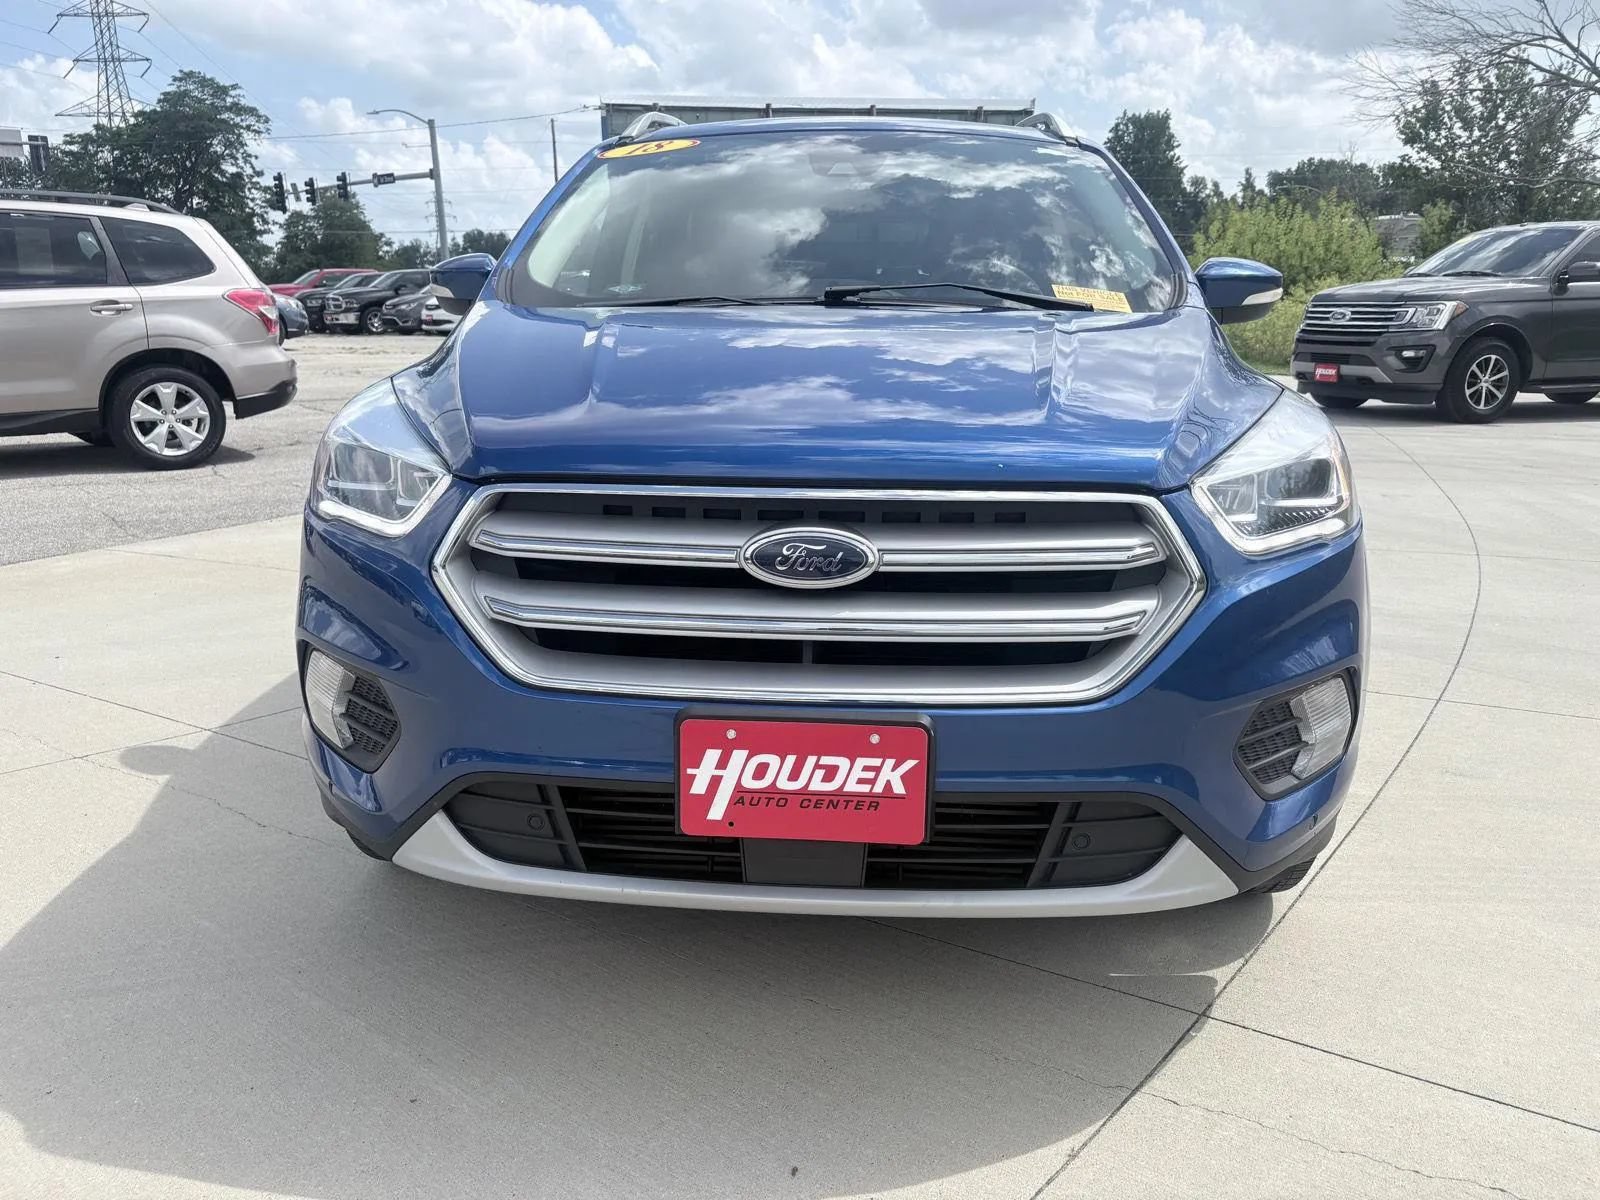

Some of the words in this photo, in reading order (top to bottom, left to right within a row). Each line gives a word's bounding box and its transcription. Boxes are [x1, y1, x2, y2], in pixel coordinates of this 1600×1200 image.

[775, 543, 843, 571] Ford
[686, 748, 920, 821] HOUDEK
[733, 796, 788, 808] AUTO
[799, 799, 880, 812] CENTER
